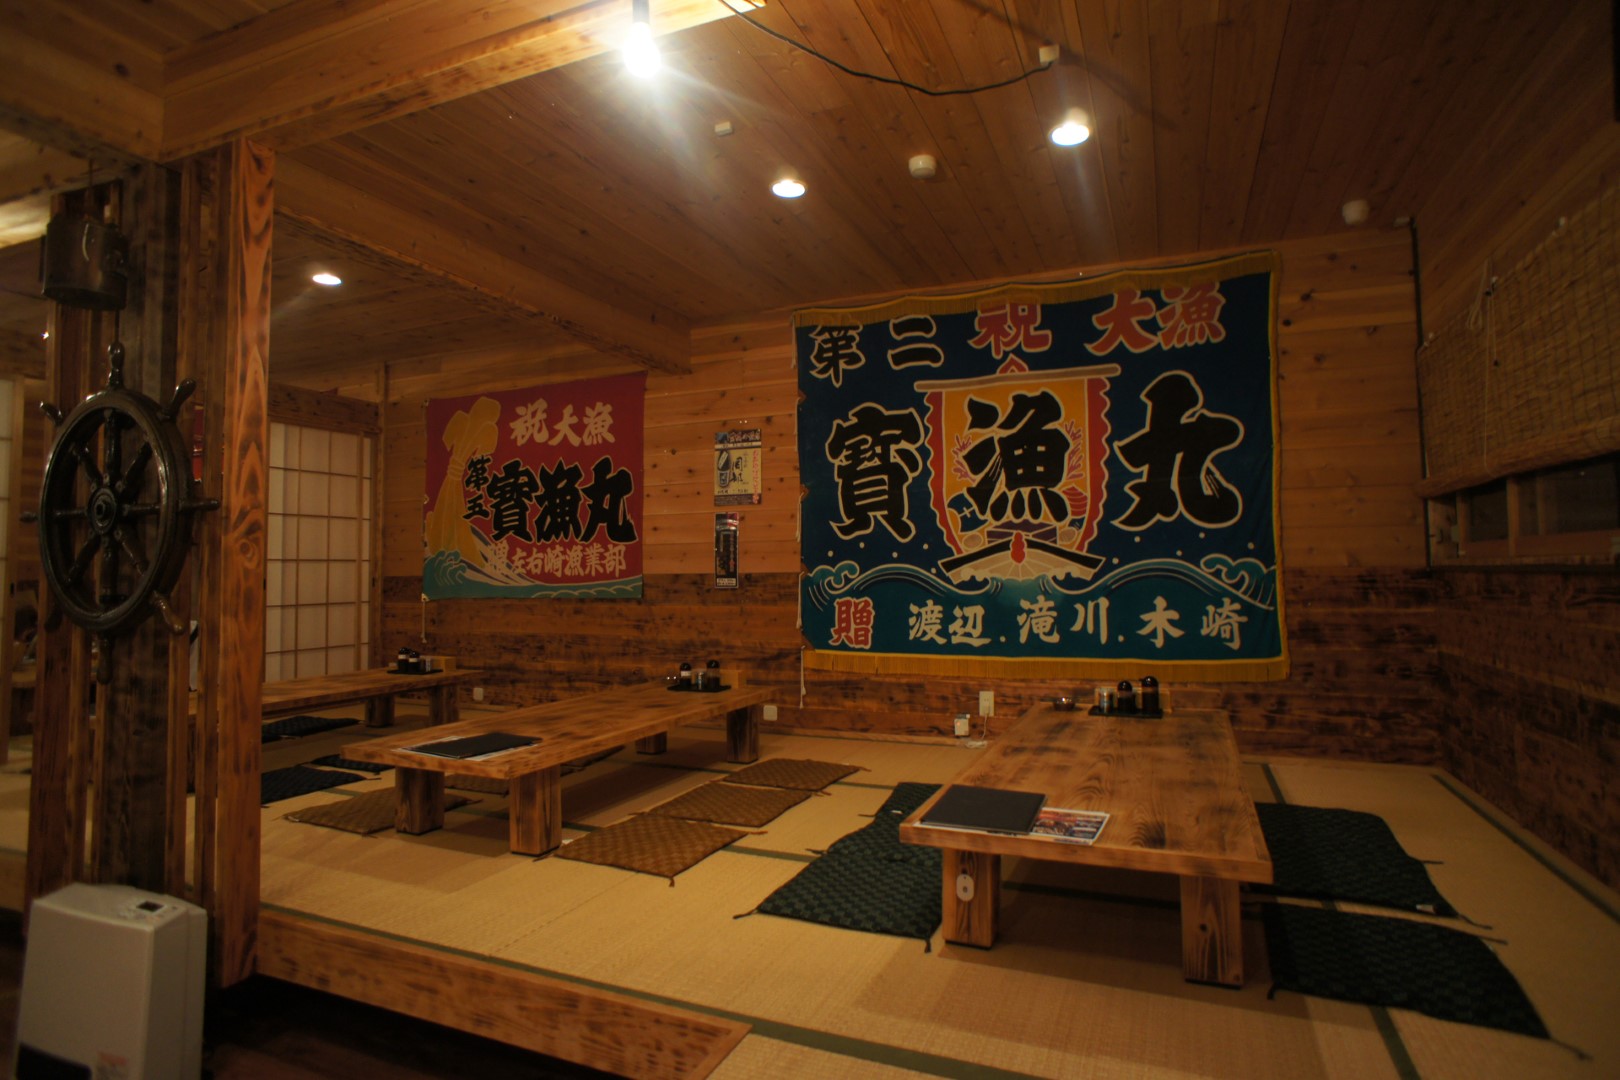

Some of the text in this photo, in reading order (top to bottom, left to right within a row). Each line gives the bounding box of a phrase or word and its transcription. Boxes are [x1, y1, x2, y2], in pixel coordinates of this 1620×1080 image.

[509, 398, 616, 447] 祝大漁
[463, 454, 492, 520] 第五
[828, 596, 875, 650] 贈
